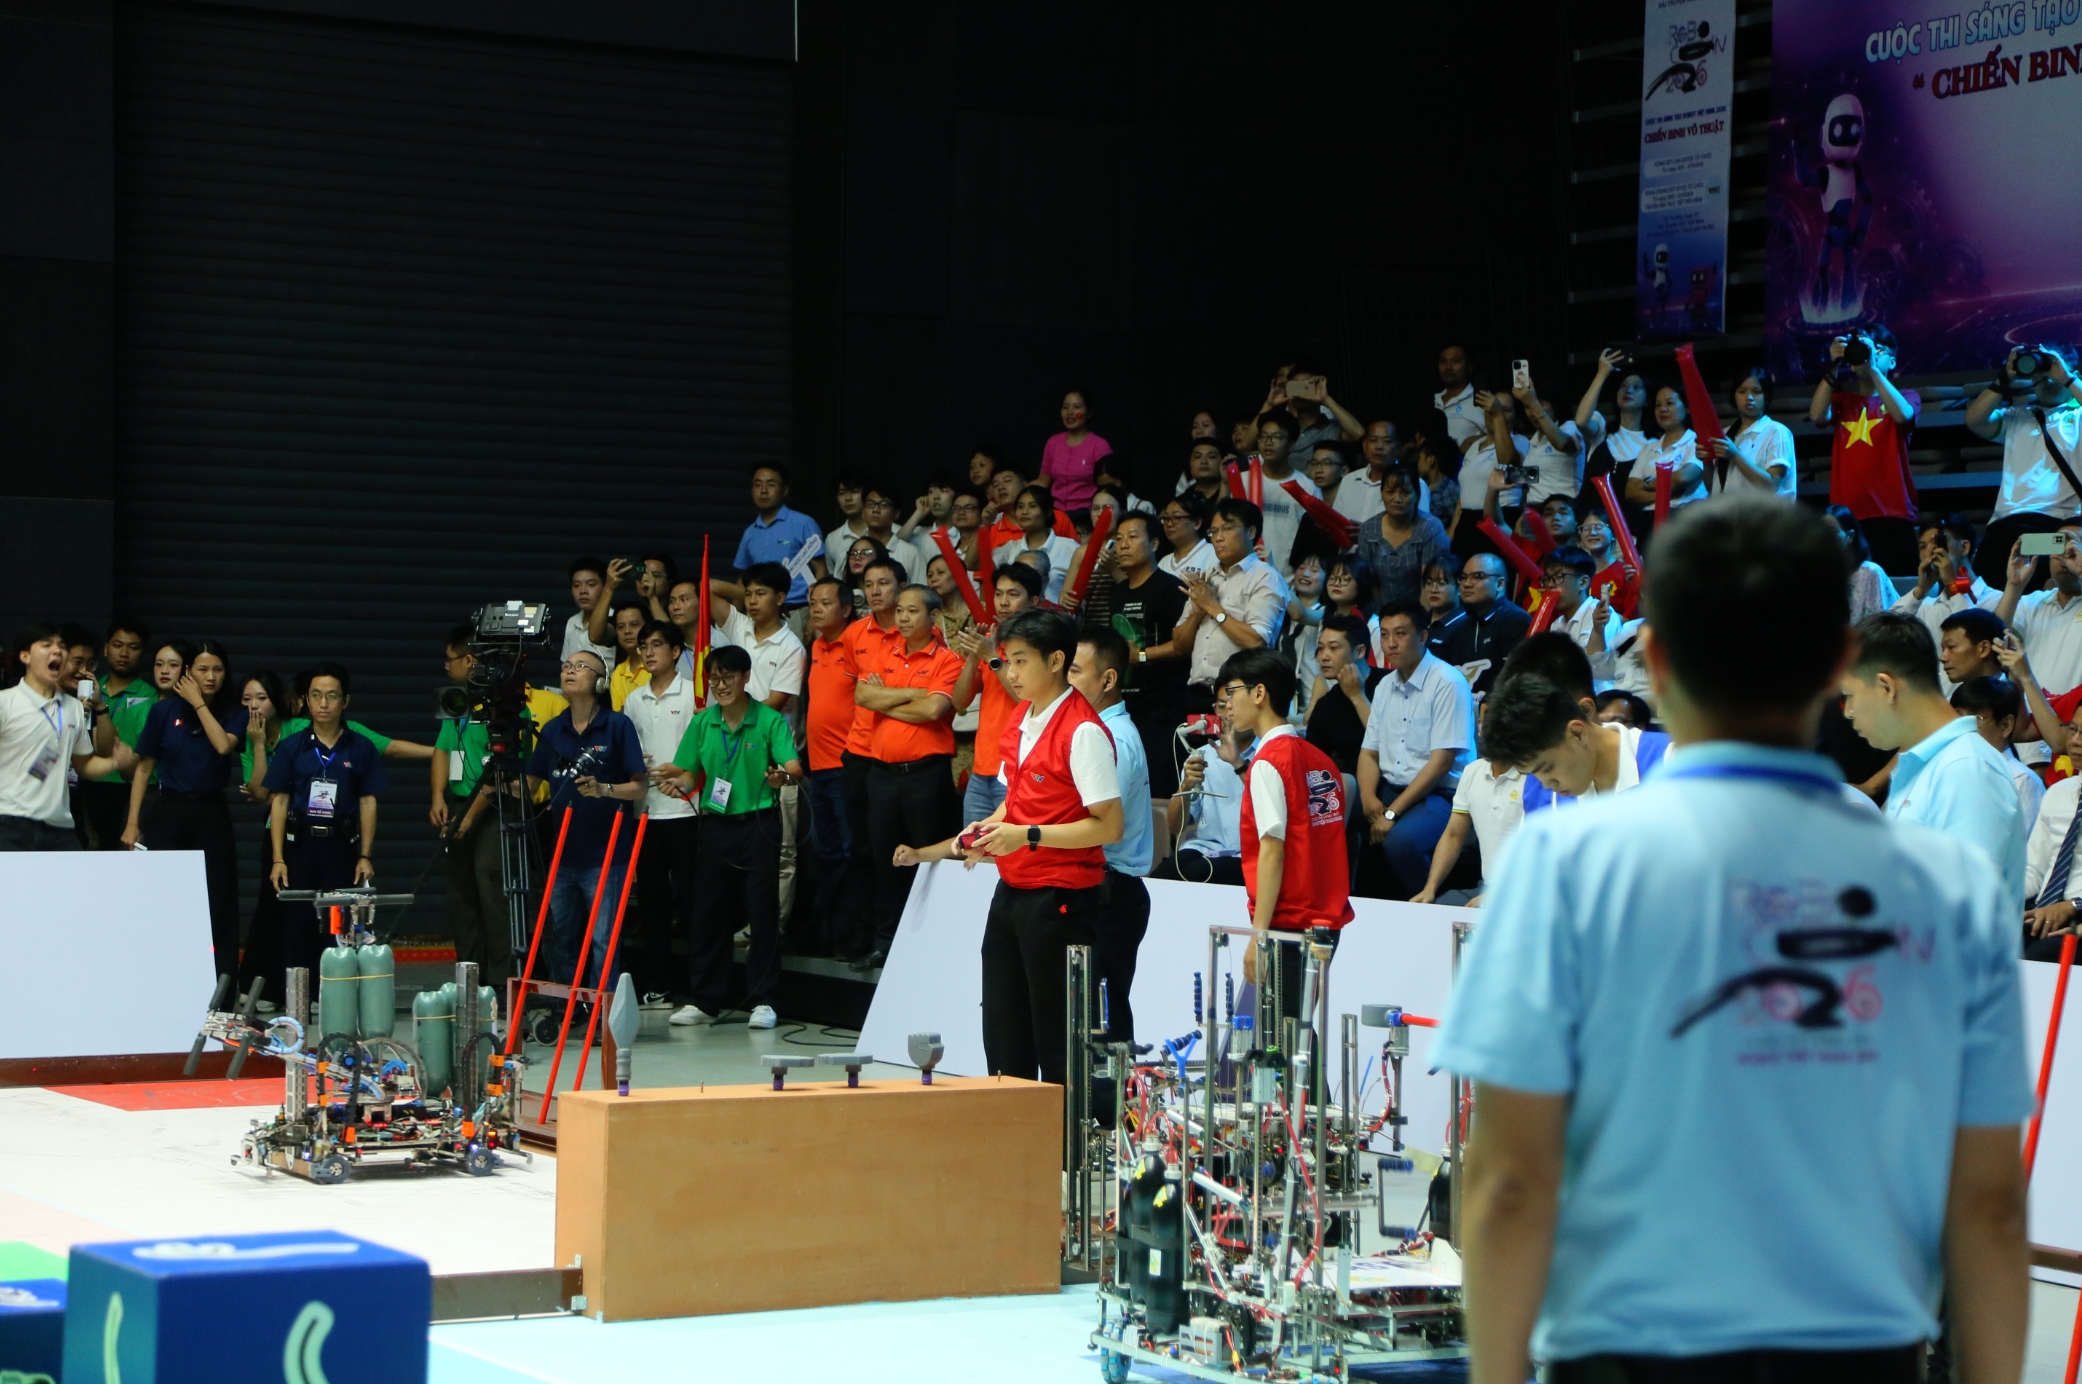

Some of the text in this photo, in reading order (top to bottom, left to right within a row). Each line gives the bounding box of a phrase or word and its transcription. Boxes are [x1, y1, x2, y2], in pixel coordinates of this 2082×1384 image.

[1865, 0, 2081, 65] CUỘC THI SÁNG TẠO
[1931, 44, 2023, 99] CHIẾN
[2027, 42, 2082, 83] BIN
[1644, 127, 1666, 143] CHIẾN
[1667, 127, 1686, 140] BINH
[1699, 119, 1725, 134] THUẬT
[1030, 771, 1045, 783] VTV
